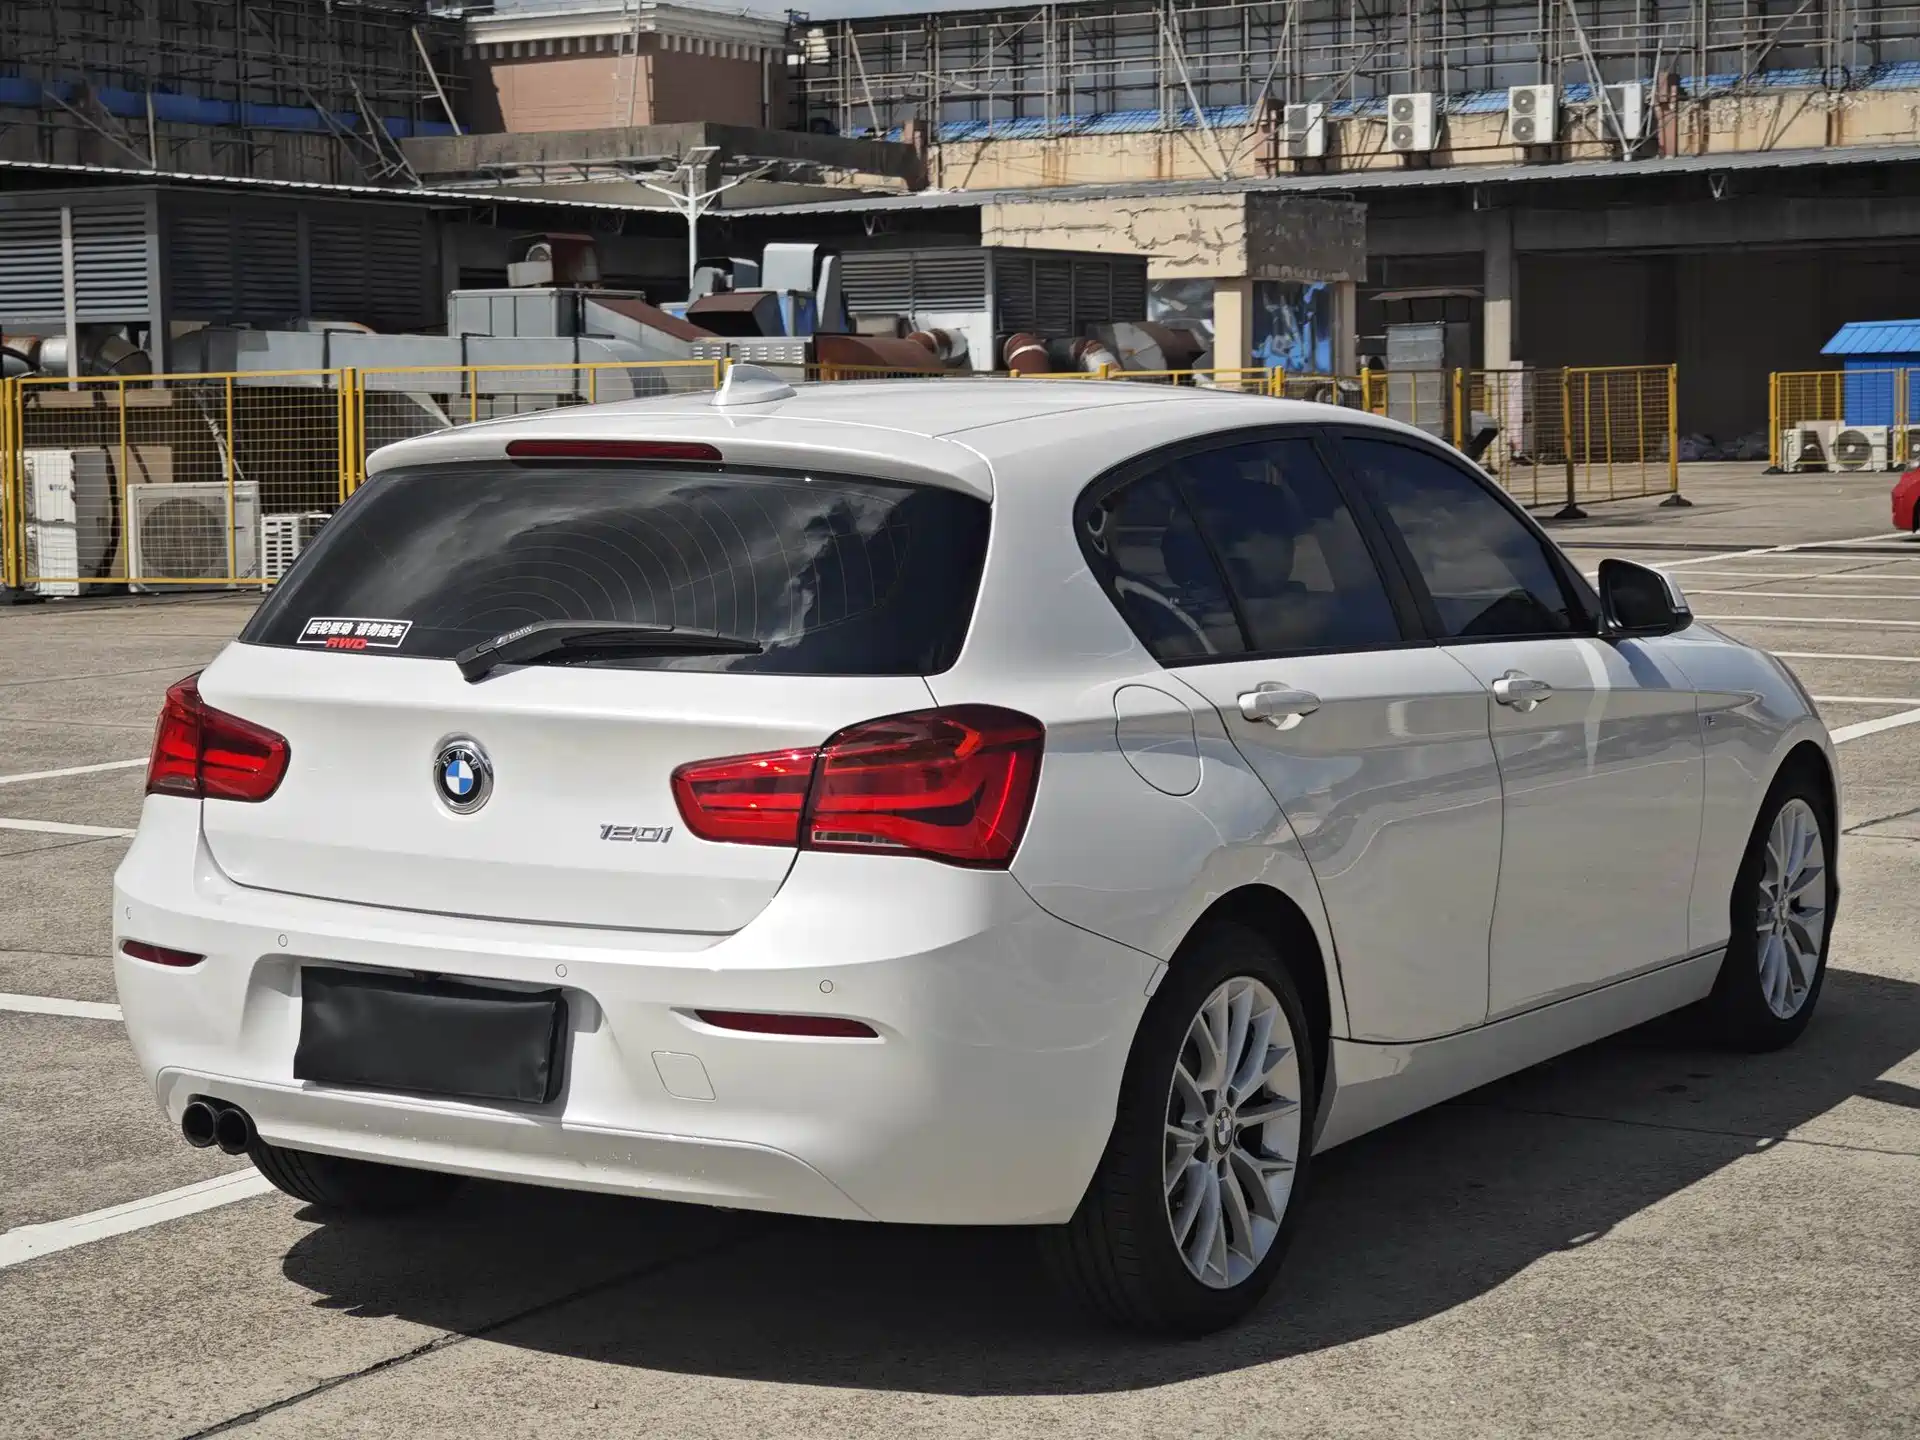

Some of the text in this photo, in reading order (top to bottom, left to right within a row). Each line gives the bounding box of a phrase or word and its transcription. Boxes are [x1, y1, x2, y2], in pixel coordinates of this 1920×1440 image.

[306, 621, 353, 635] 后轮驱动
[325, 637, 368, 649] RWD
[442, 750, 480, 770] BMW
